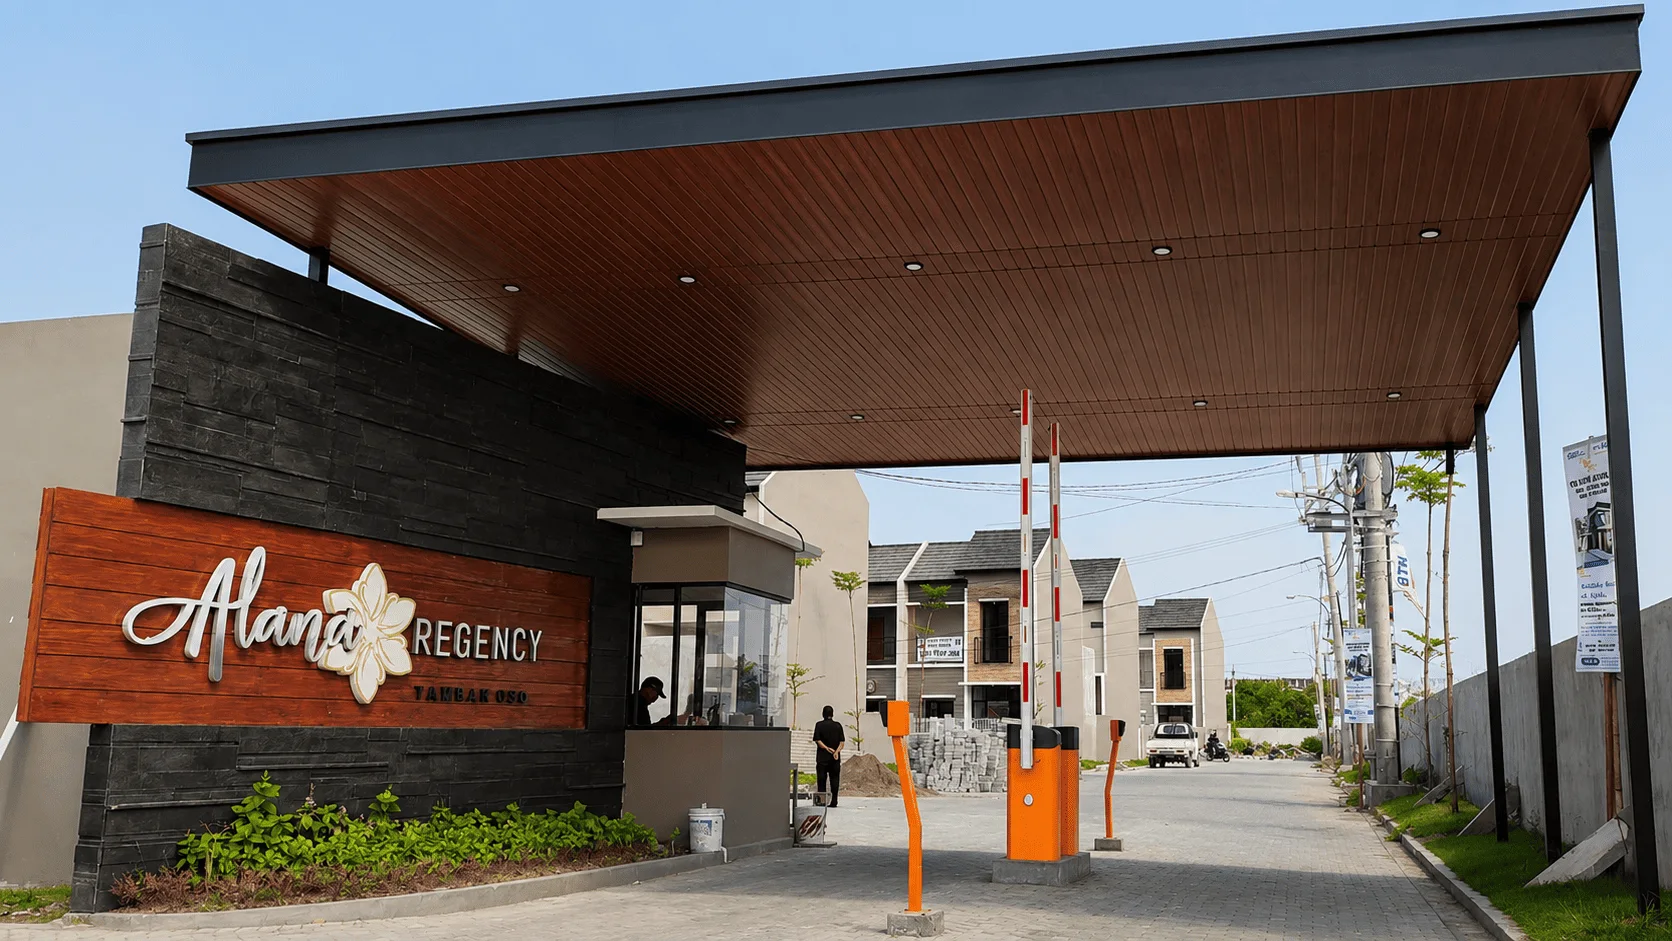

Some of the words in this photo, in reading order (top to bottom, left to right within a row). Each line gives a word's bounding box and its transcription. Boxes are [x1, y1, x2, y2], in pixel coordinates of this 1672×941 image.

[122, 546, 363, 682] Alana
[412, 617, 542, 662] REGENCY
[413, 685, 490, 703] TAMBAK
[496, 689, 528, 704] OSO
